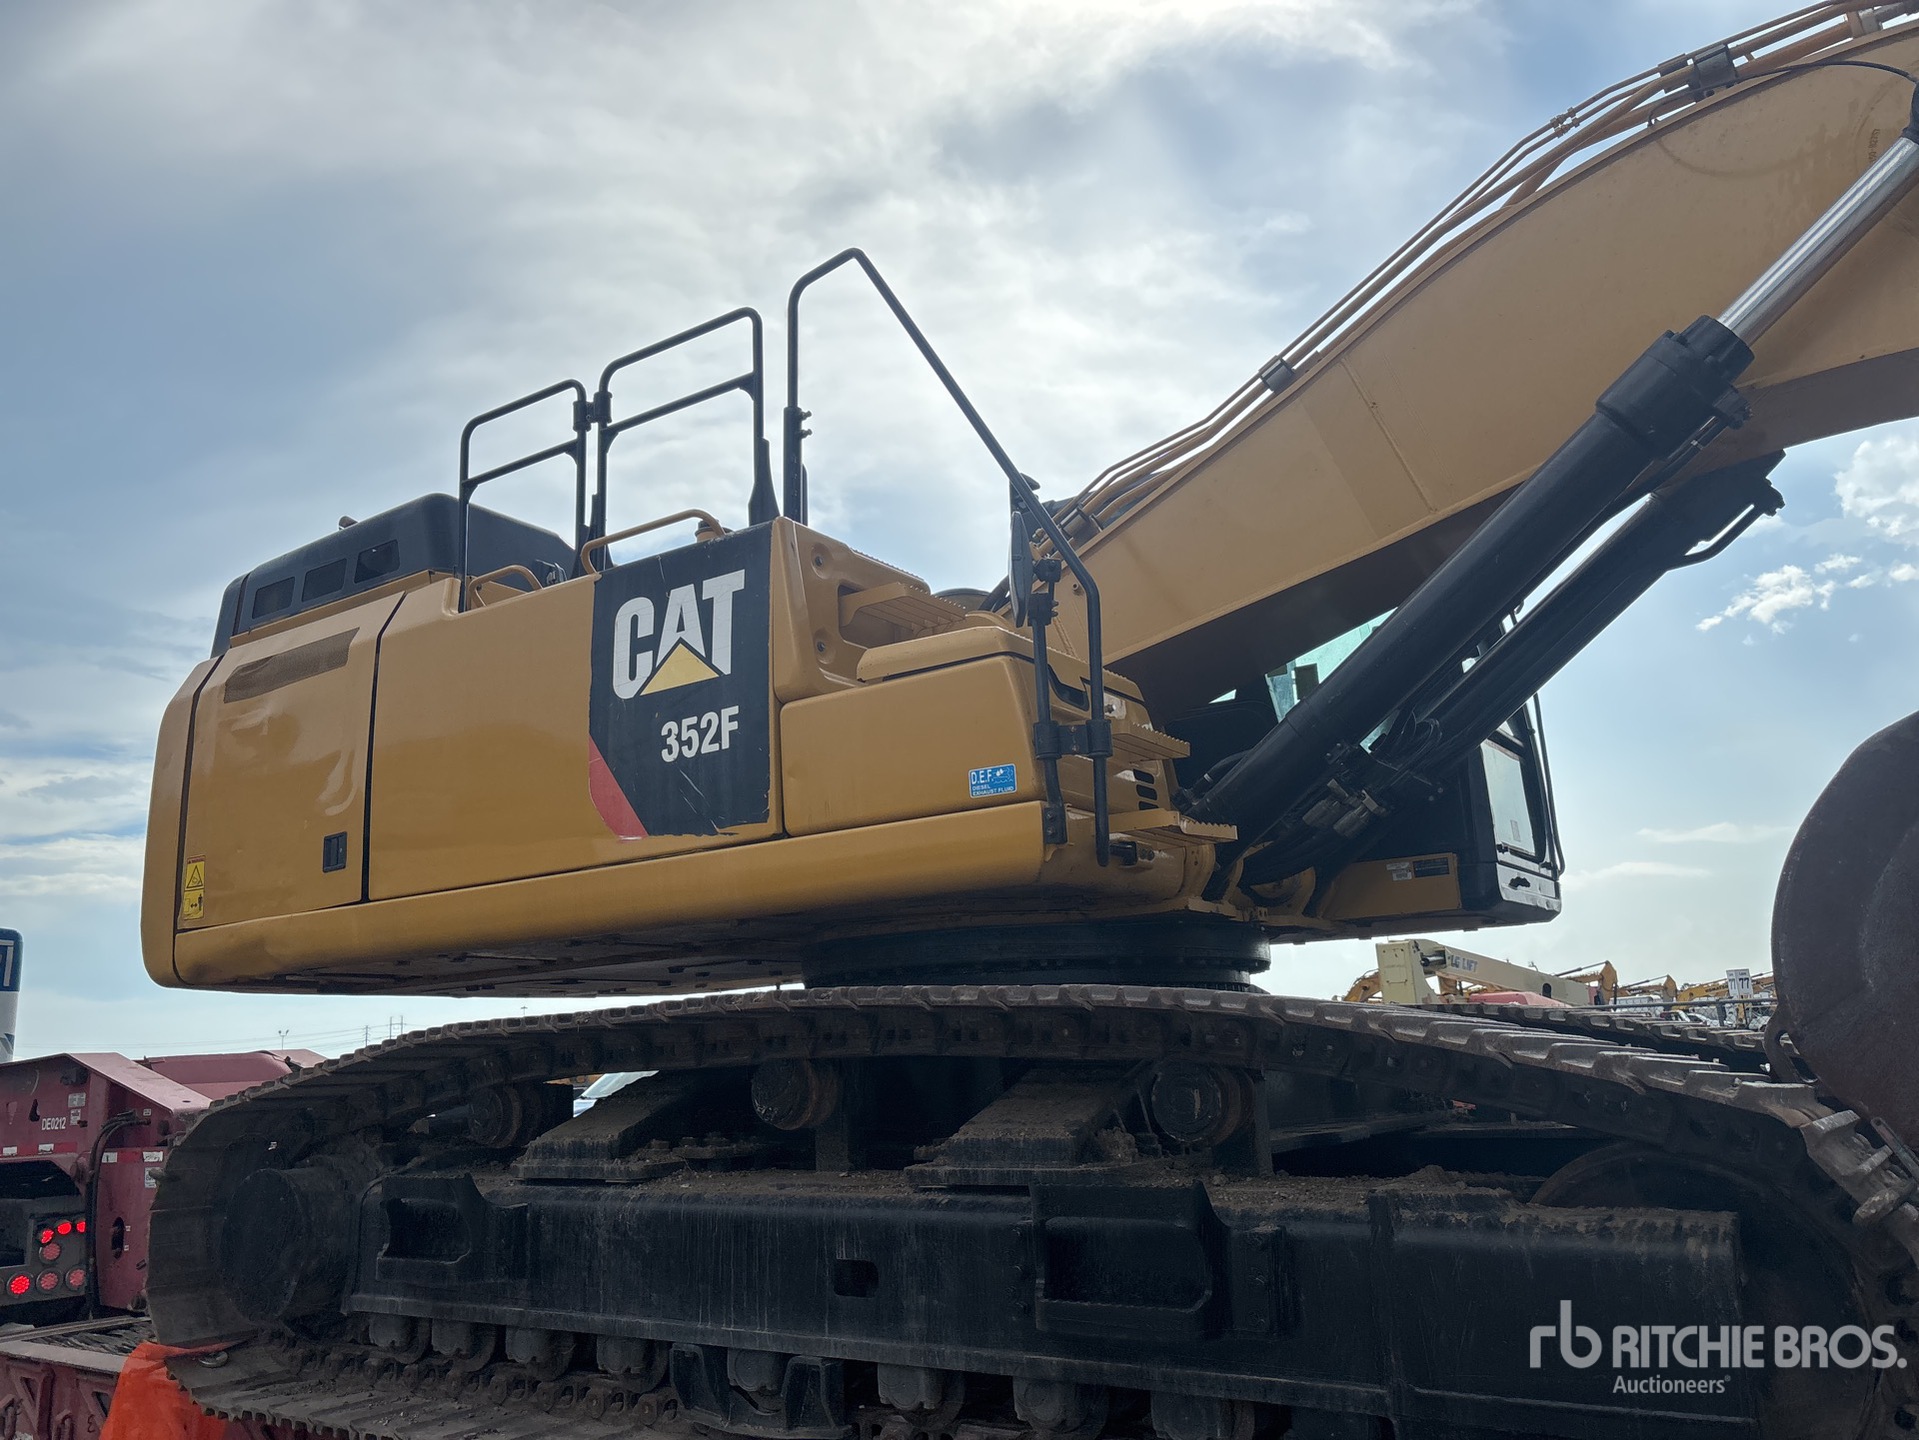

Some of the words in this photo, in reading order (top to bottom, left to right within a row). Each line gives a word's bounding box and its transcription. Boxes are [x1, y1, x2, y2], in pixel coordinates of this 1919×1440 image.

[613, 569, 745, 700] CAT
[661, 705, 739, 763] 352F
[973, 788, 996, 796] EXHAUST
[1738, 977, 1750, 989] 77
[41, 1116, 67, 1131] DE0212
